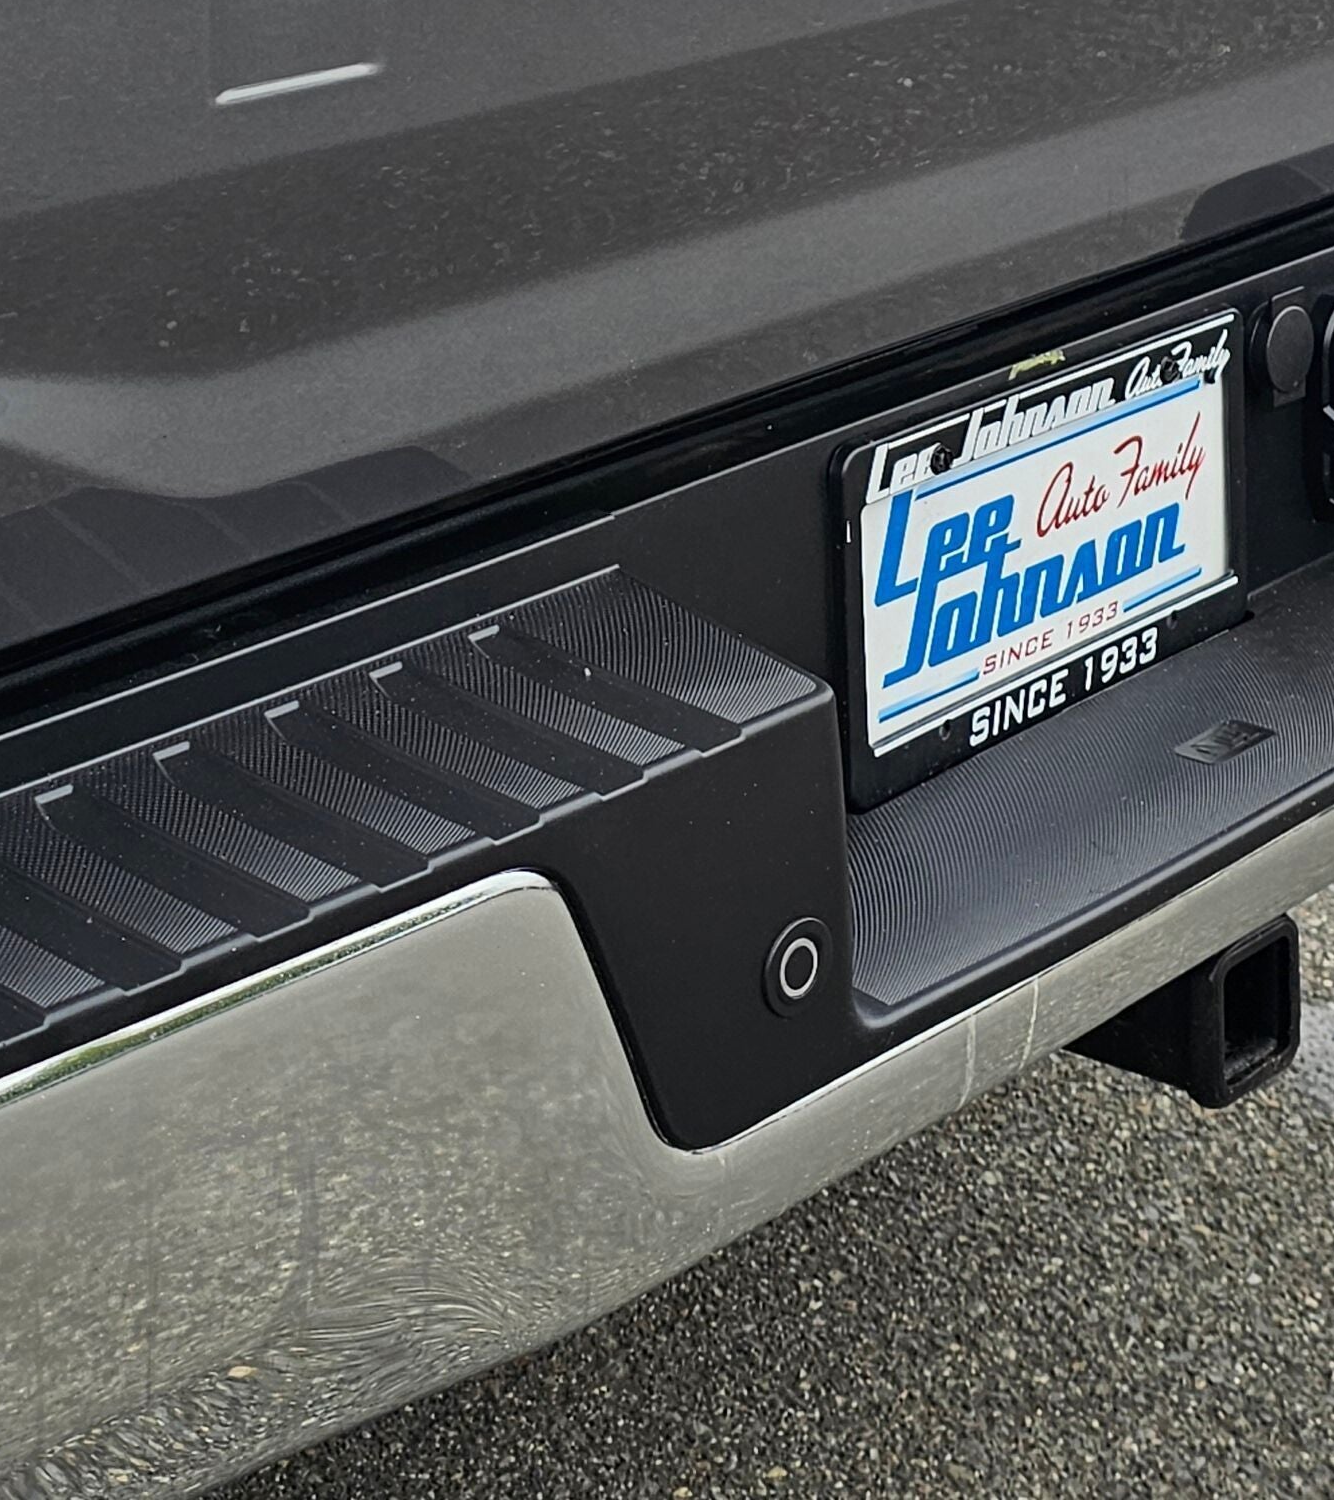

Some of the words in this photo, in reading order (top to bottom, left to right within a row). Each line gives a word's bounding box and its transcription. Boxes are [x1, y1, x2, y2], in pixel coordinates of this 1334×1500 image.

[950, 377, 1116, 471] Johnson
[1125, 356, 1175, 400] Aut
[1170, 329, 1231, 384] Family
[1036, 462, 1110, 537] Auto
[1113, 412, 1206, 508] Family
[874, 489, 1021, 607] Lee
[882, 502, 1186, 689] Johnson
[969, 669, 1069, 747] SINCE
[1084, 627, 1158, 692] 1933
[982, 628, 1053, 675] SINCE
[1066, 602, 1119, 638] 1933
